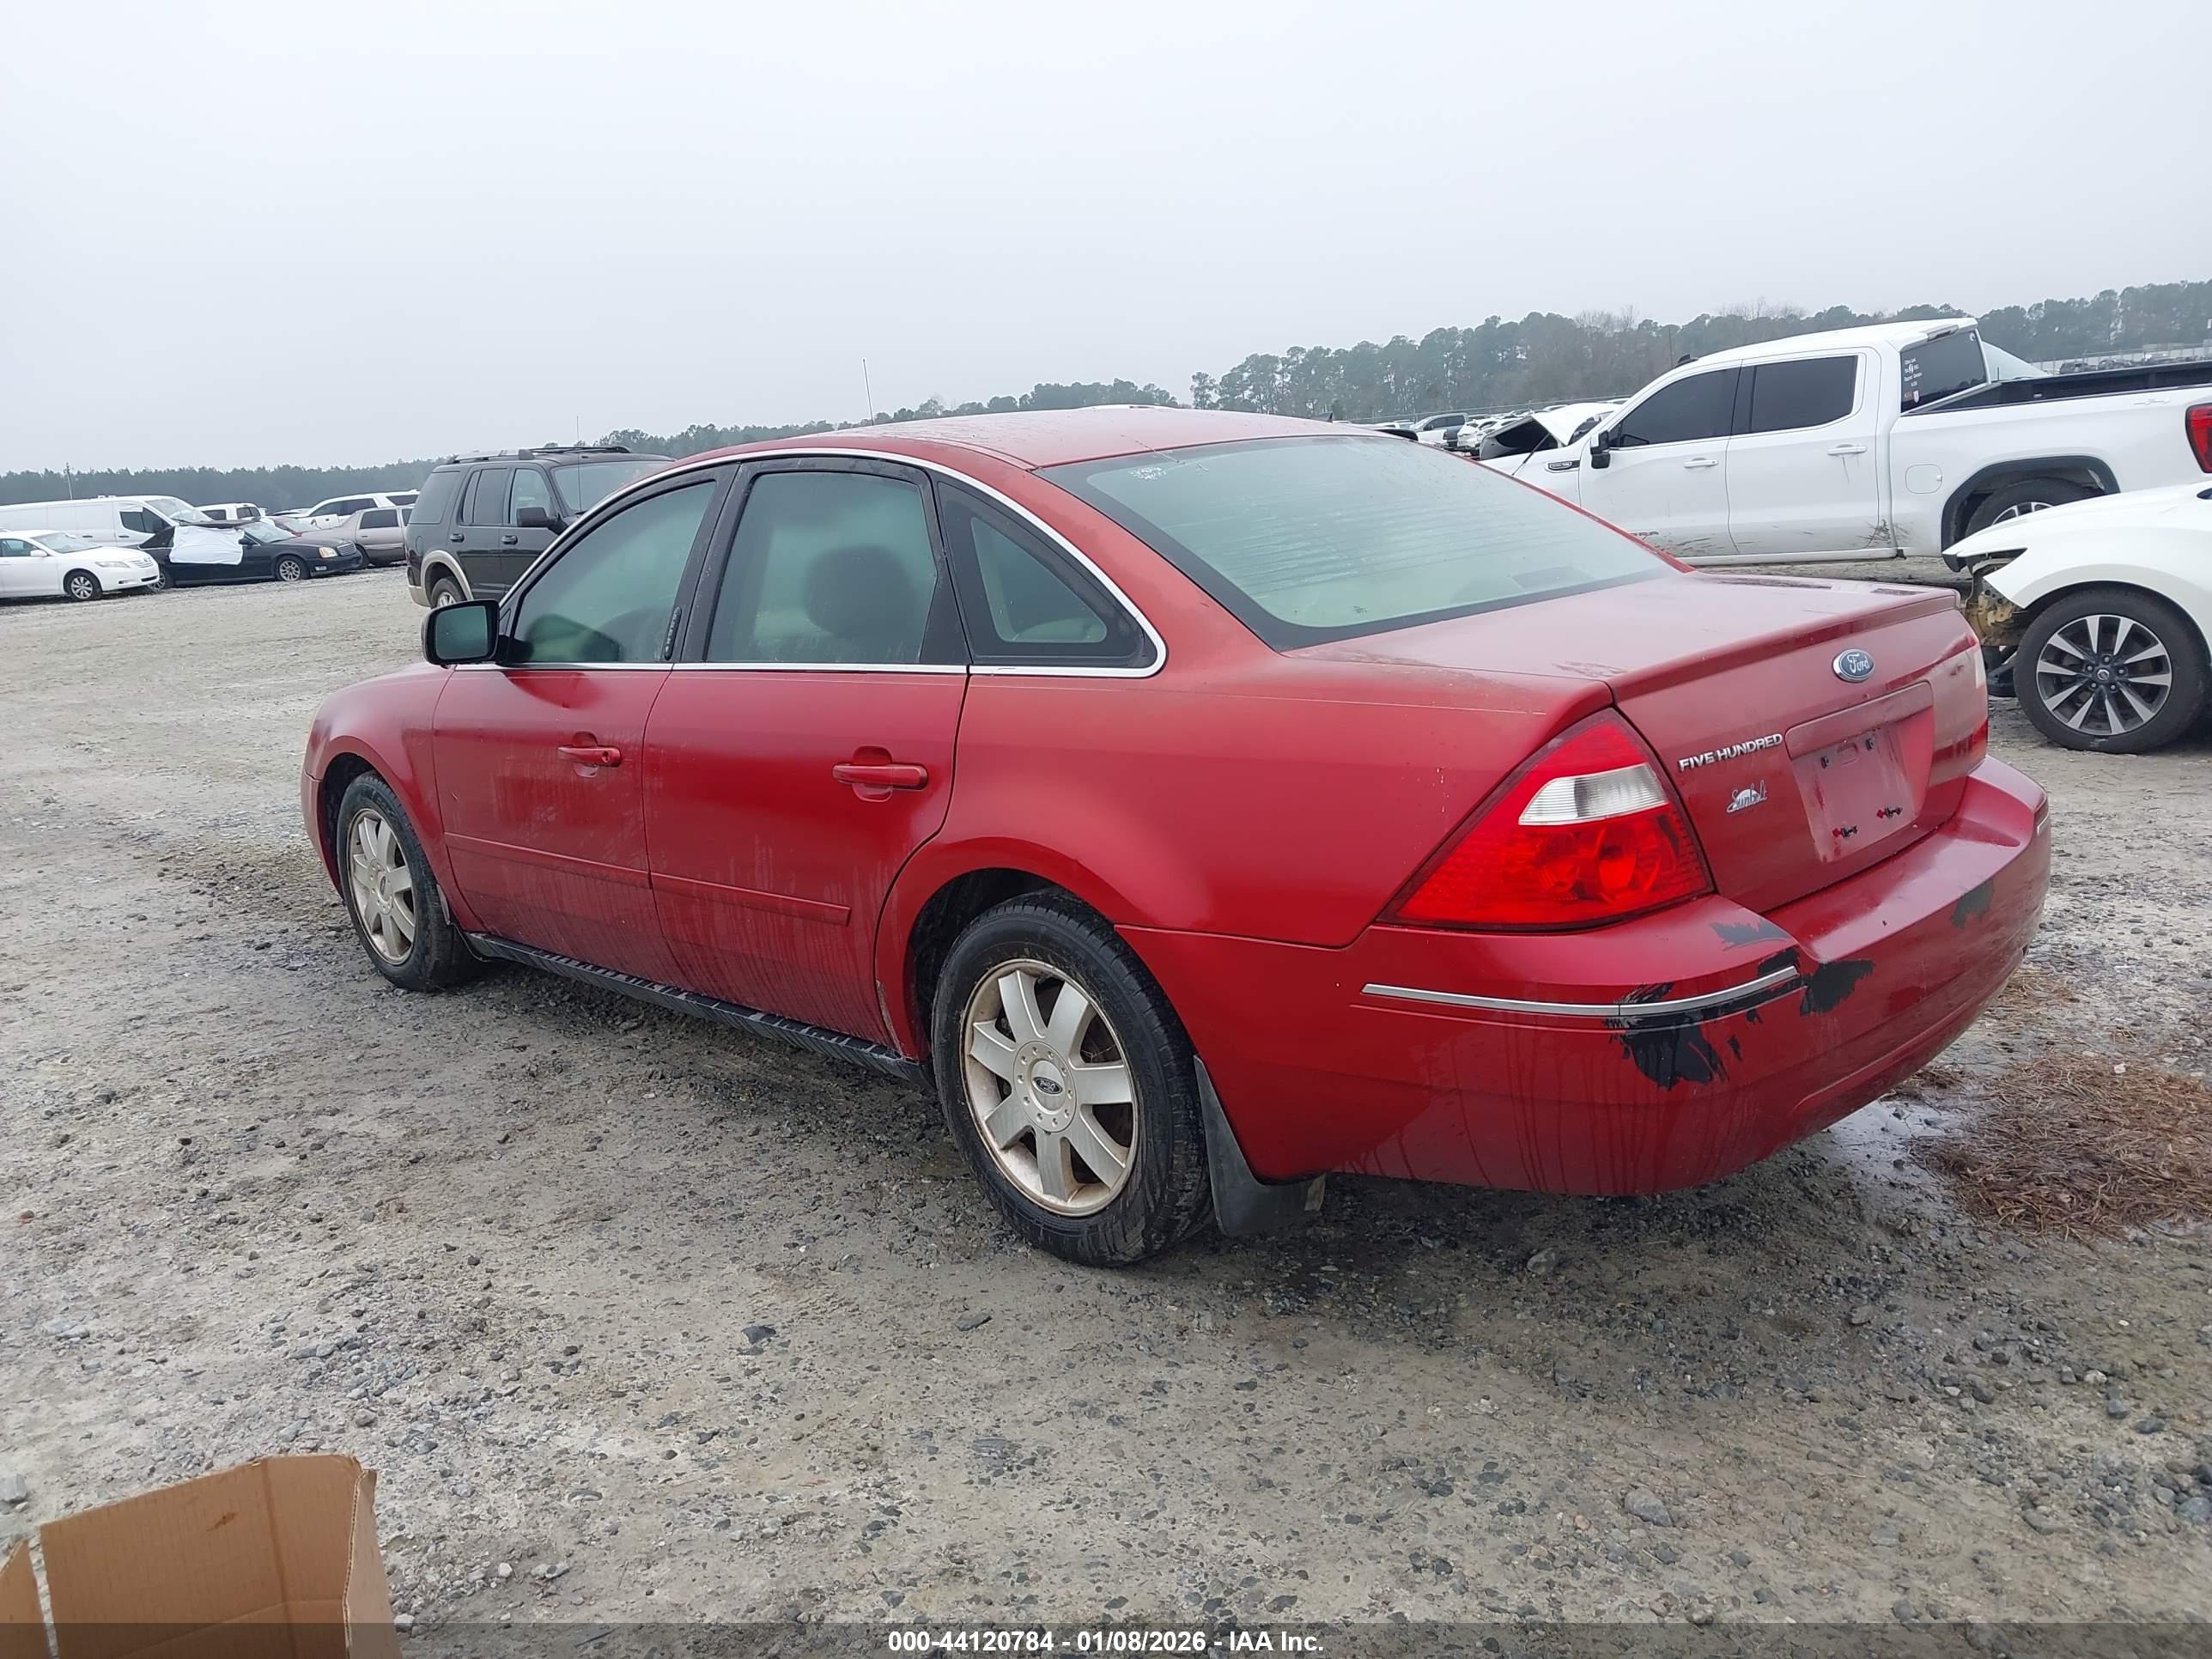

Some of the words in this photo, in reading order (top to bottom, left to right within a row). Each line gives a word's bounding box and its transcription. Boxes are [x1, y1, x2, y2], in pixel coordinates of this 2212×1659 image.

[1846, 652, 1869, 674] Ford
[1679, 752, 1714, 771] FIVE
[1717, 733, 1783, 761] HUNDRED
